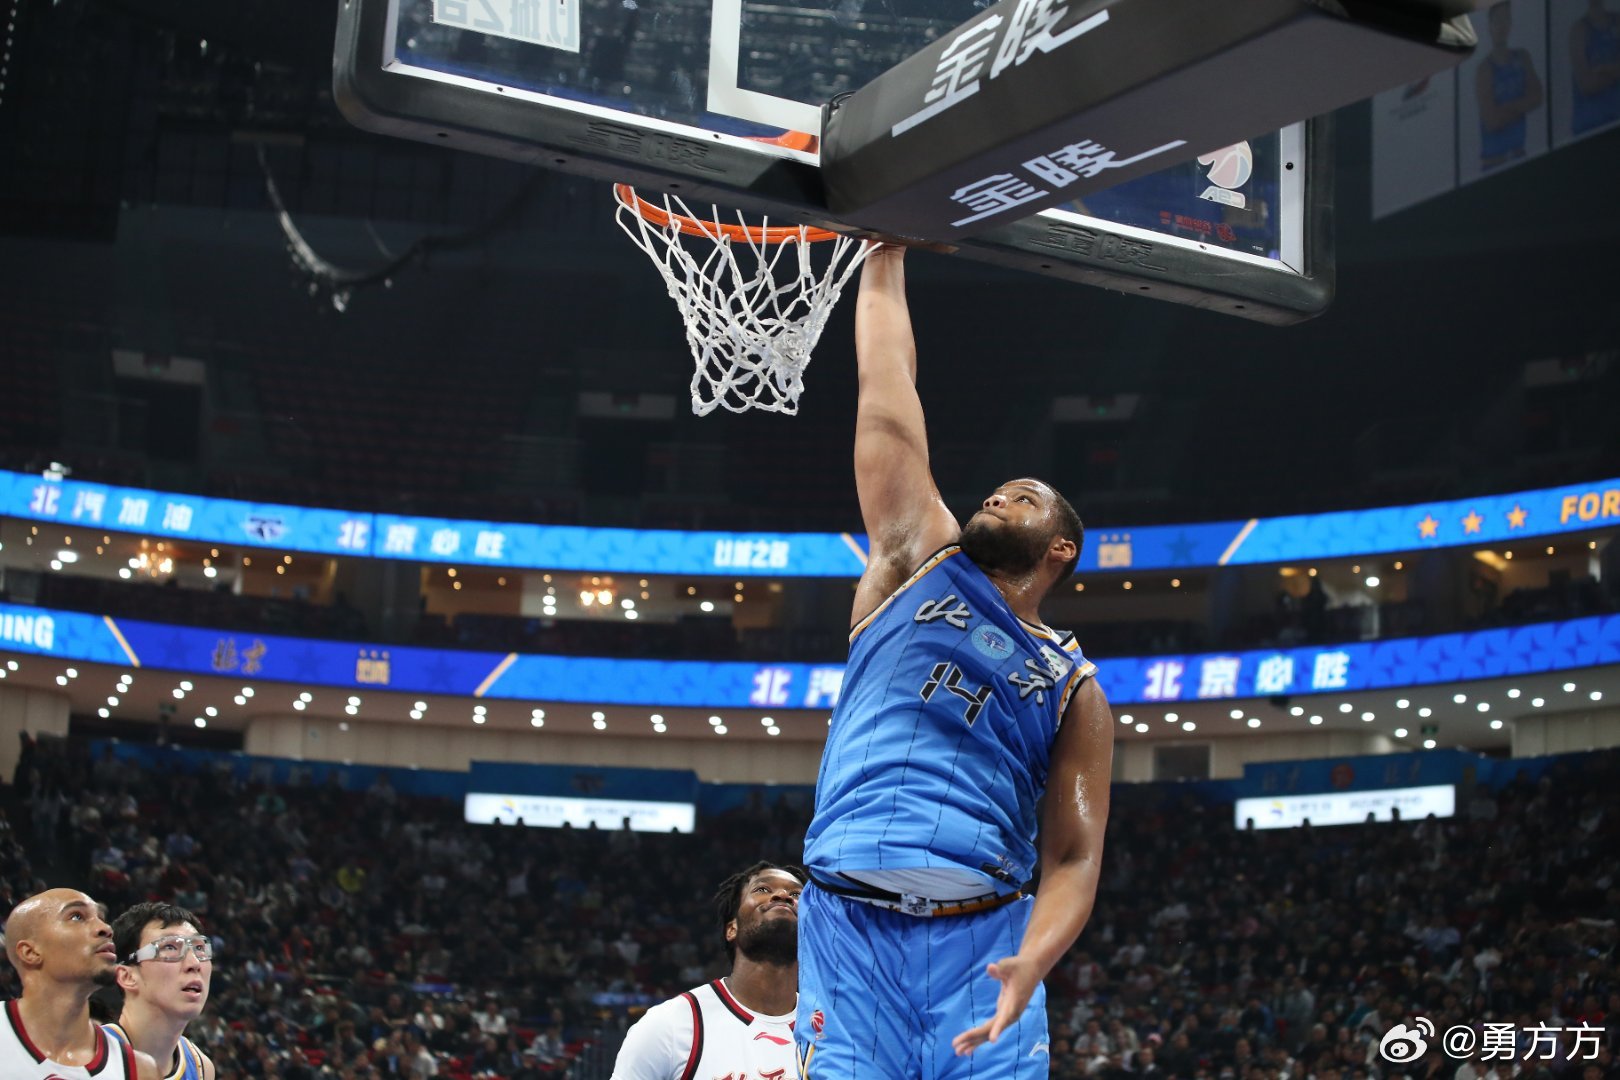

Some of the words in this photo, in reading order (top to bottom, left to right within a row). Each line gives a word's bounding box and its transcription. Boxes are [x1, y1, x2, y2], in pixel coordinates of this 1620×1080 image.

[892, 0, 1110, 137] 金陵
[950, 139, 1188, 227] 金陵
[31, 485, 193, 531] 北汽加油
[1560, 490, 1620, 524] FOR
[337, 519, 504, 559] 北京必胜
[920, 662, 993, 728] 14
[1143, 651, 1350, 699] 北京必胜
